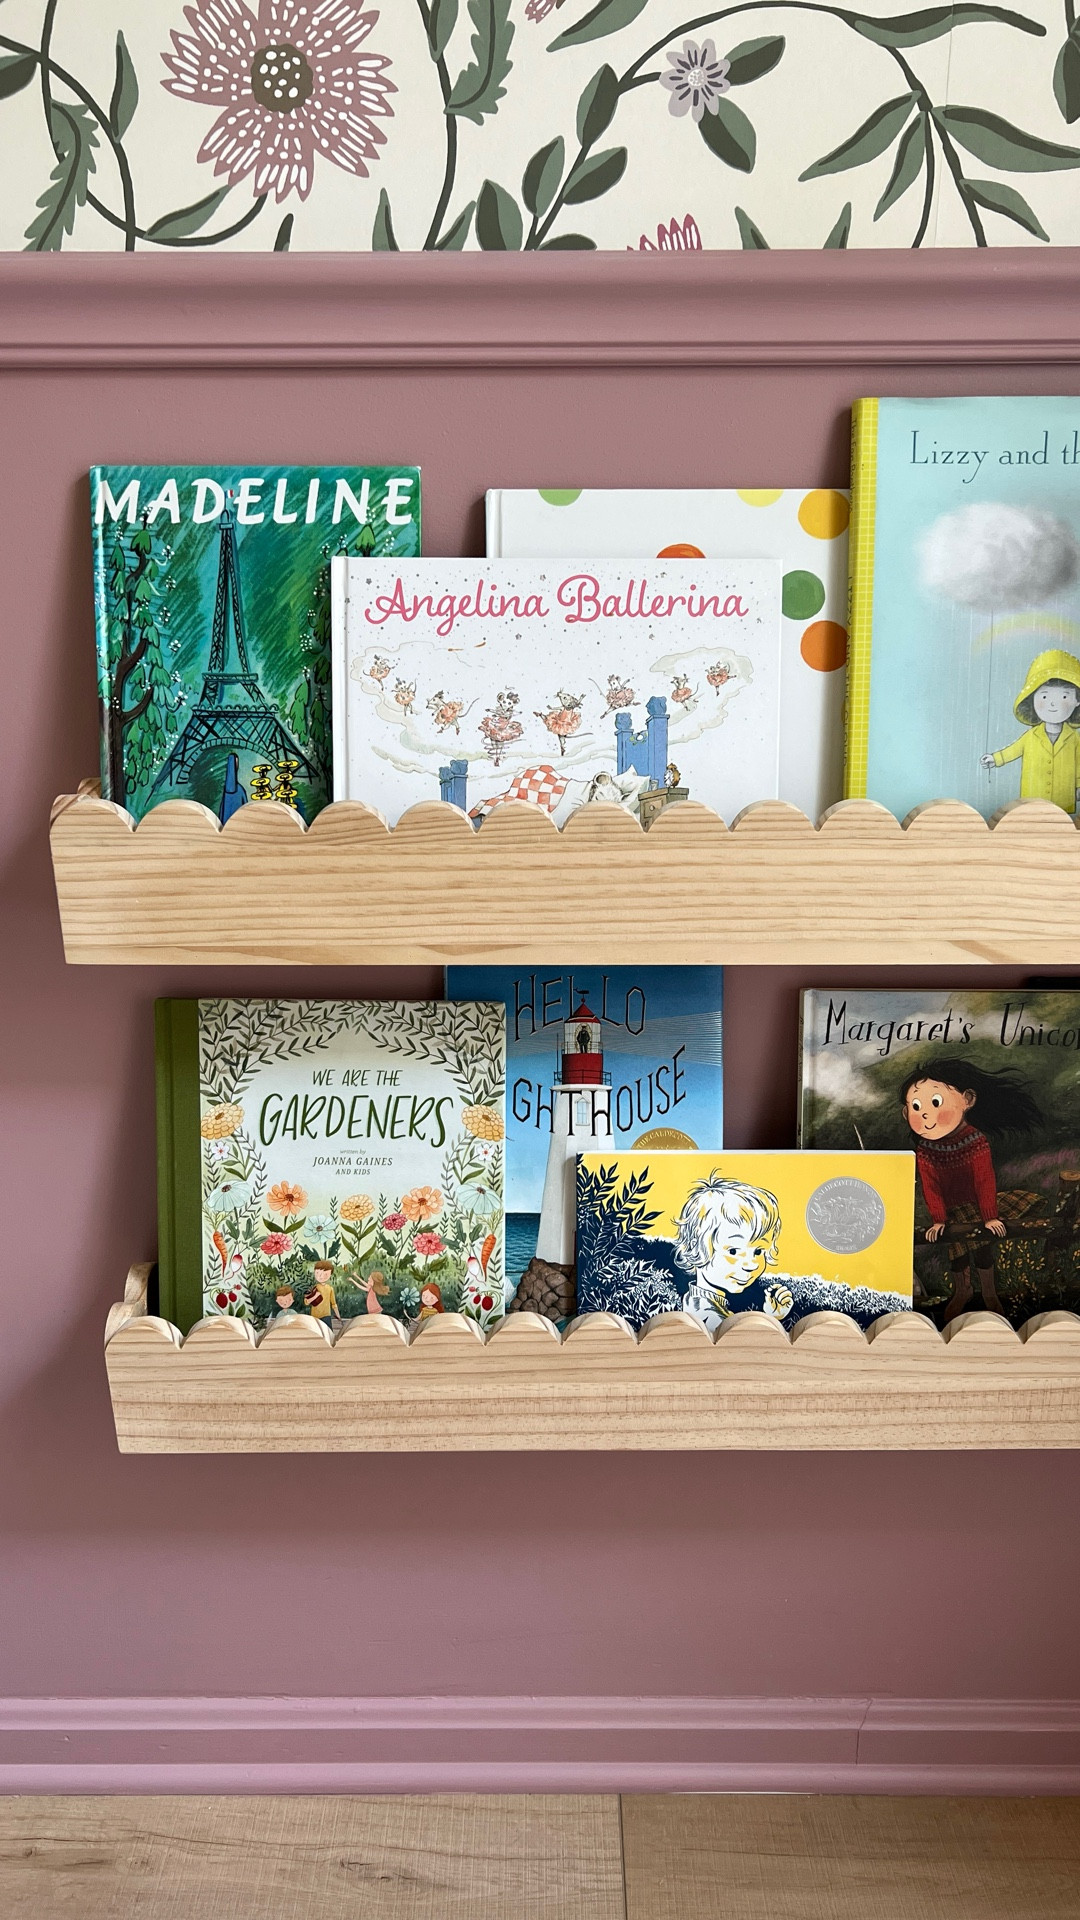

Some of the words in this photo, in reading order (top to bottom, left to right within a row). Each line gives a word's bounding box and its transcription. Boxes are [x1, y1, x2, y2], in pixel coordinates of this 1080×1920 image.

[909, 430, 990, 484] Lizzy
[998, 430, 1050, 465] and
[94, 478, 414, 525] MADELINE
[364, 577, 550, 637] Angelina
[556, 574, 750, 624] Ballerina
[512, 973, 646, 1042] HELLO
[822, 998, 976, 1057] Margaret's
[312, 1069, 336, 1086] WE
[342, 1069, 371, 1087] ARE
[376, 1069, 403, 1087] THE
[511, 1045, 687, 1138] GHTHOUSE
[259, 1093, 454, 1148] GARDENERS
[312, 1156, 352, 1168] JOANNA
[356, 1157, 394, 1166] GAINES
